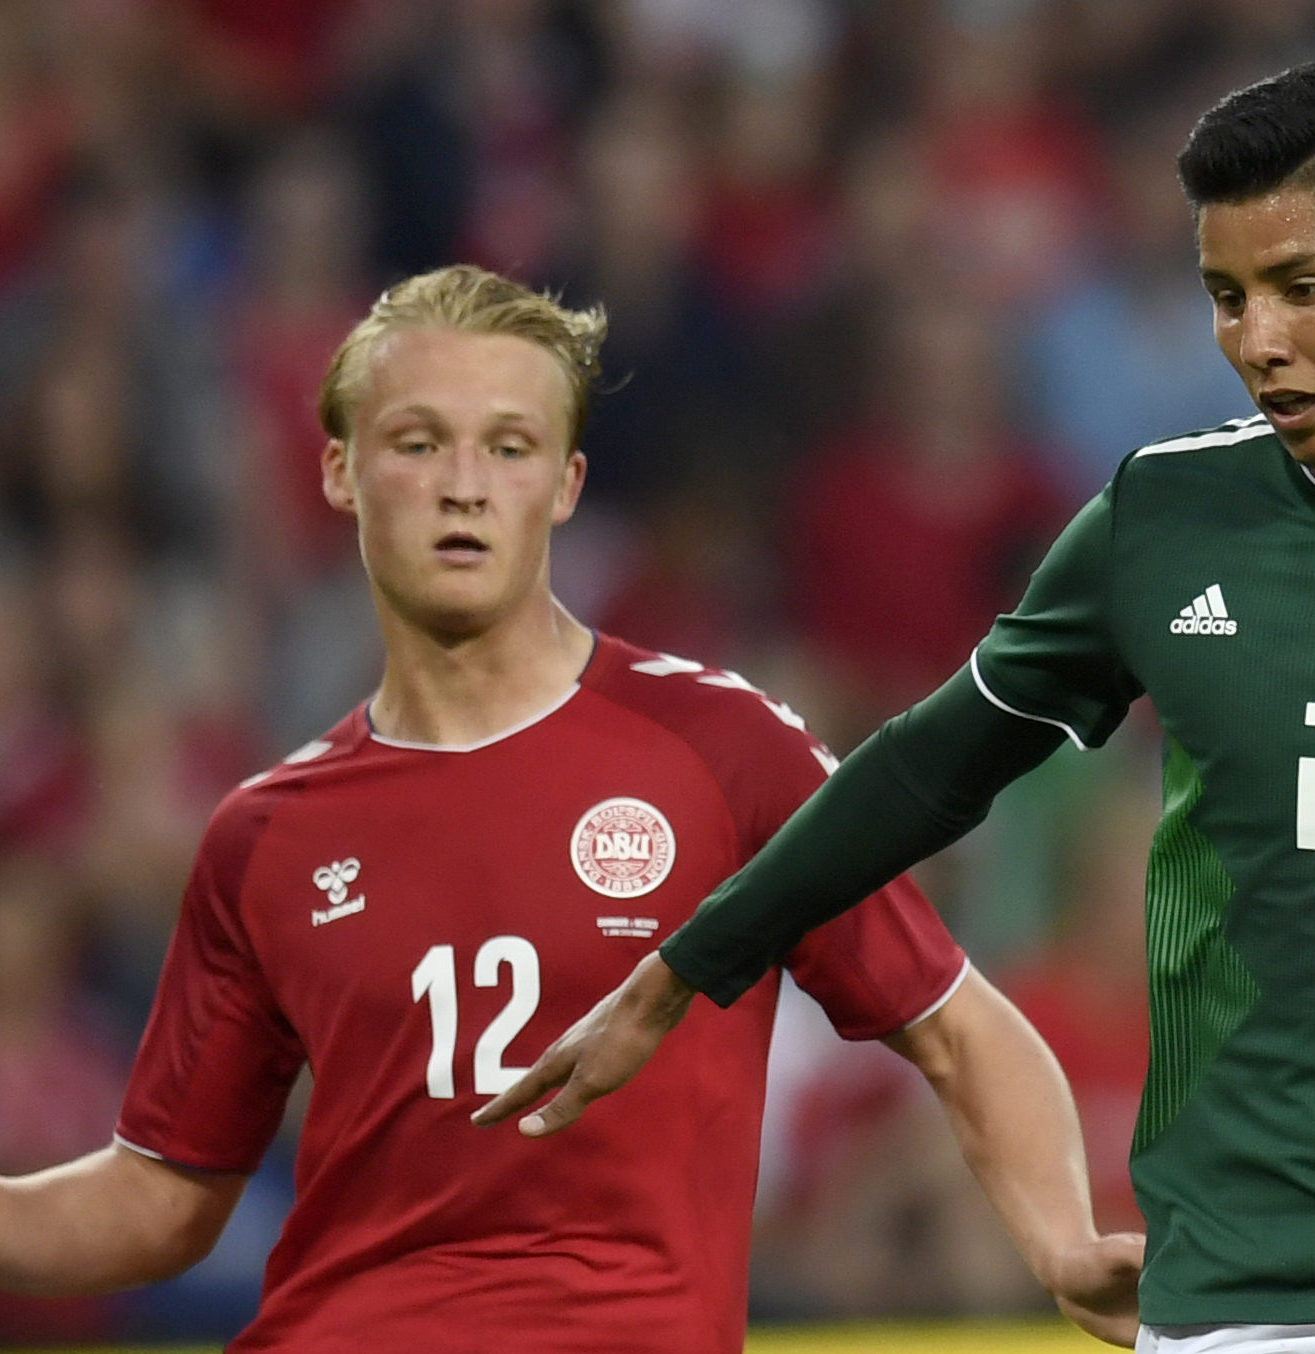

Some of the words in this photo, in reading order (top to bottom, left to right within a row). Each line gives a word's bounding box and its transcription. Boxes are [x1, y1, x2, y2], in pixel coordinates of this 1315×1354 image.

[1169, 615, 1238, 636] adidas
[595, 831, 651, 861] DBU
[604, 877, 644, 893] 1889
[411, 934, 542, 1100] 12
